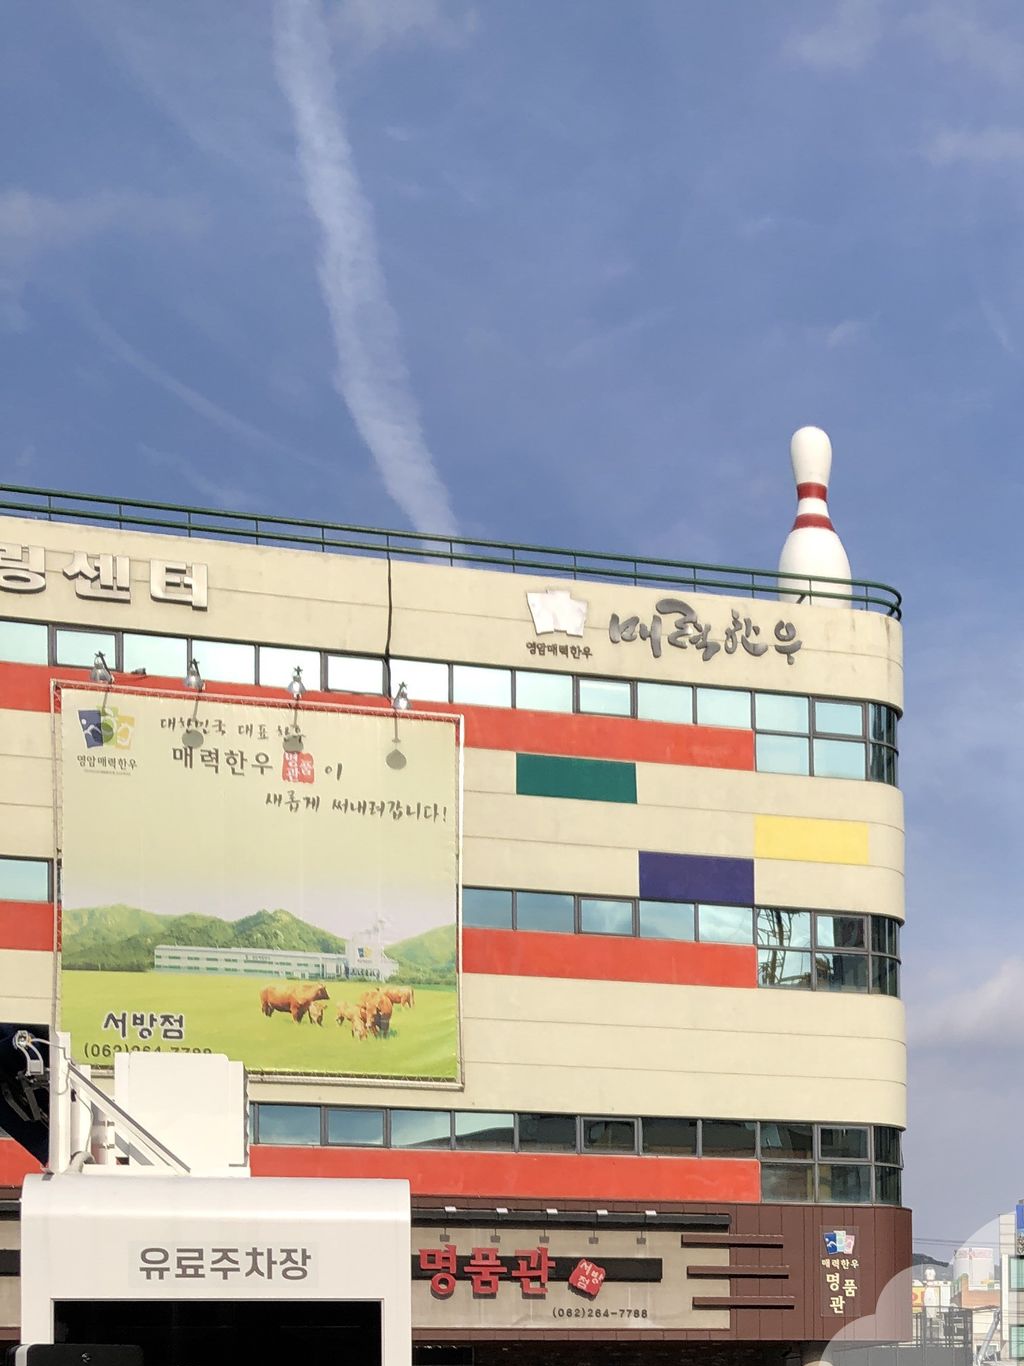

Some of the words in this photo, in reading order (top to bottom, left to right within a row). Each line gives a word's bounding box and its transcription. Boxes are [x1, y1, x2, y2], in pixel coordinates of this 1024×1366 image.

[609, 598, 803, 666] 매력한우
[238, 723, 268, 740] 대표
[172, 746, 273, 777] 매력한우
[325, 762, 343, 780] 이
[265, 790, 320, 812] 새롭게
[103, 1012, 184, 1041] 서방점
[139, 1247, 312, 1281] 유료주차장
[418, 1244, 556, 1295] 명품관
[821, 1258, 859, 1270] 매력한우
[552, 1307, 648, 1319] (062)264-7788
